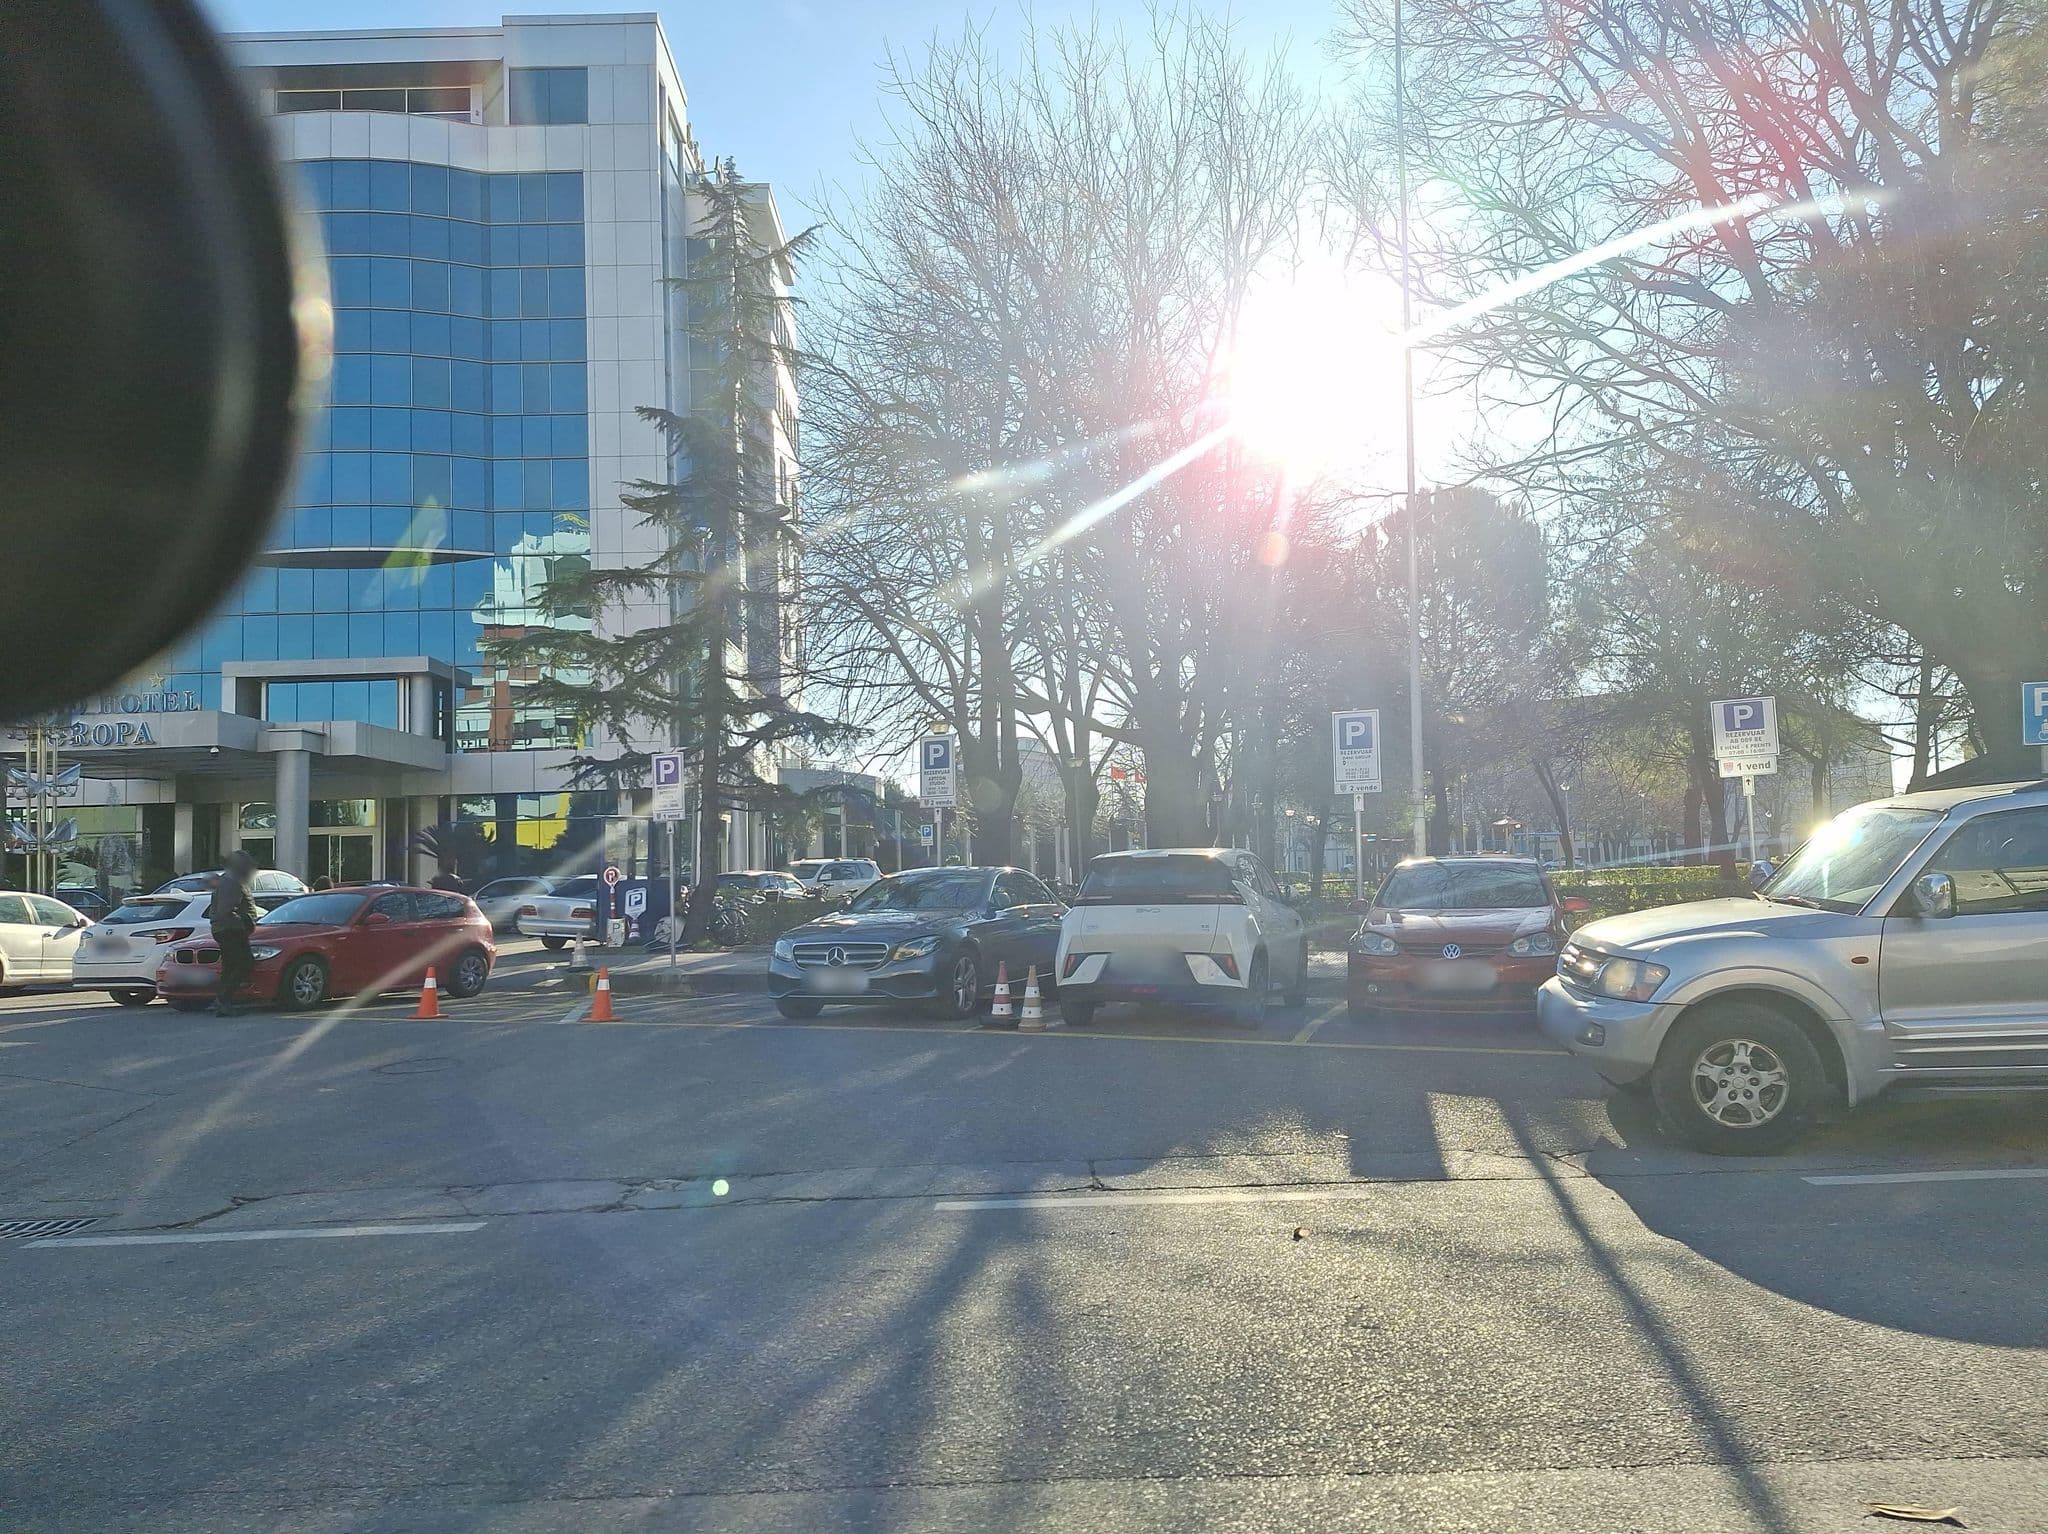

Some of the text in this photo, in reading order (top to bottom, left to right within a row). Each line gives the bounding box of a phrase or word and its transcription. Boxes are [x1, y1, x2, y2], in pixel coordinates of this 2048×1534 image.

[99, 690, 200, 715] HOTEL
[1733, 704, 1754, 729] P
[1345, 721, 1366, 746] P
[1725, 730, 1766, 738] REZERVUAR
[929, 744, 945, 766] P
[1737, 760, 1771, 771] 1 vend
[660, 760, 675, 783] P
[923, 827, 930, 836] P
[630, 893, 642, 906] P
